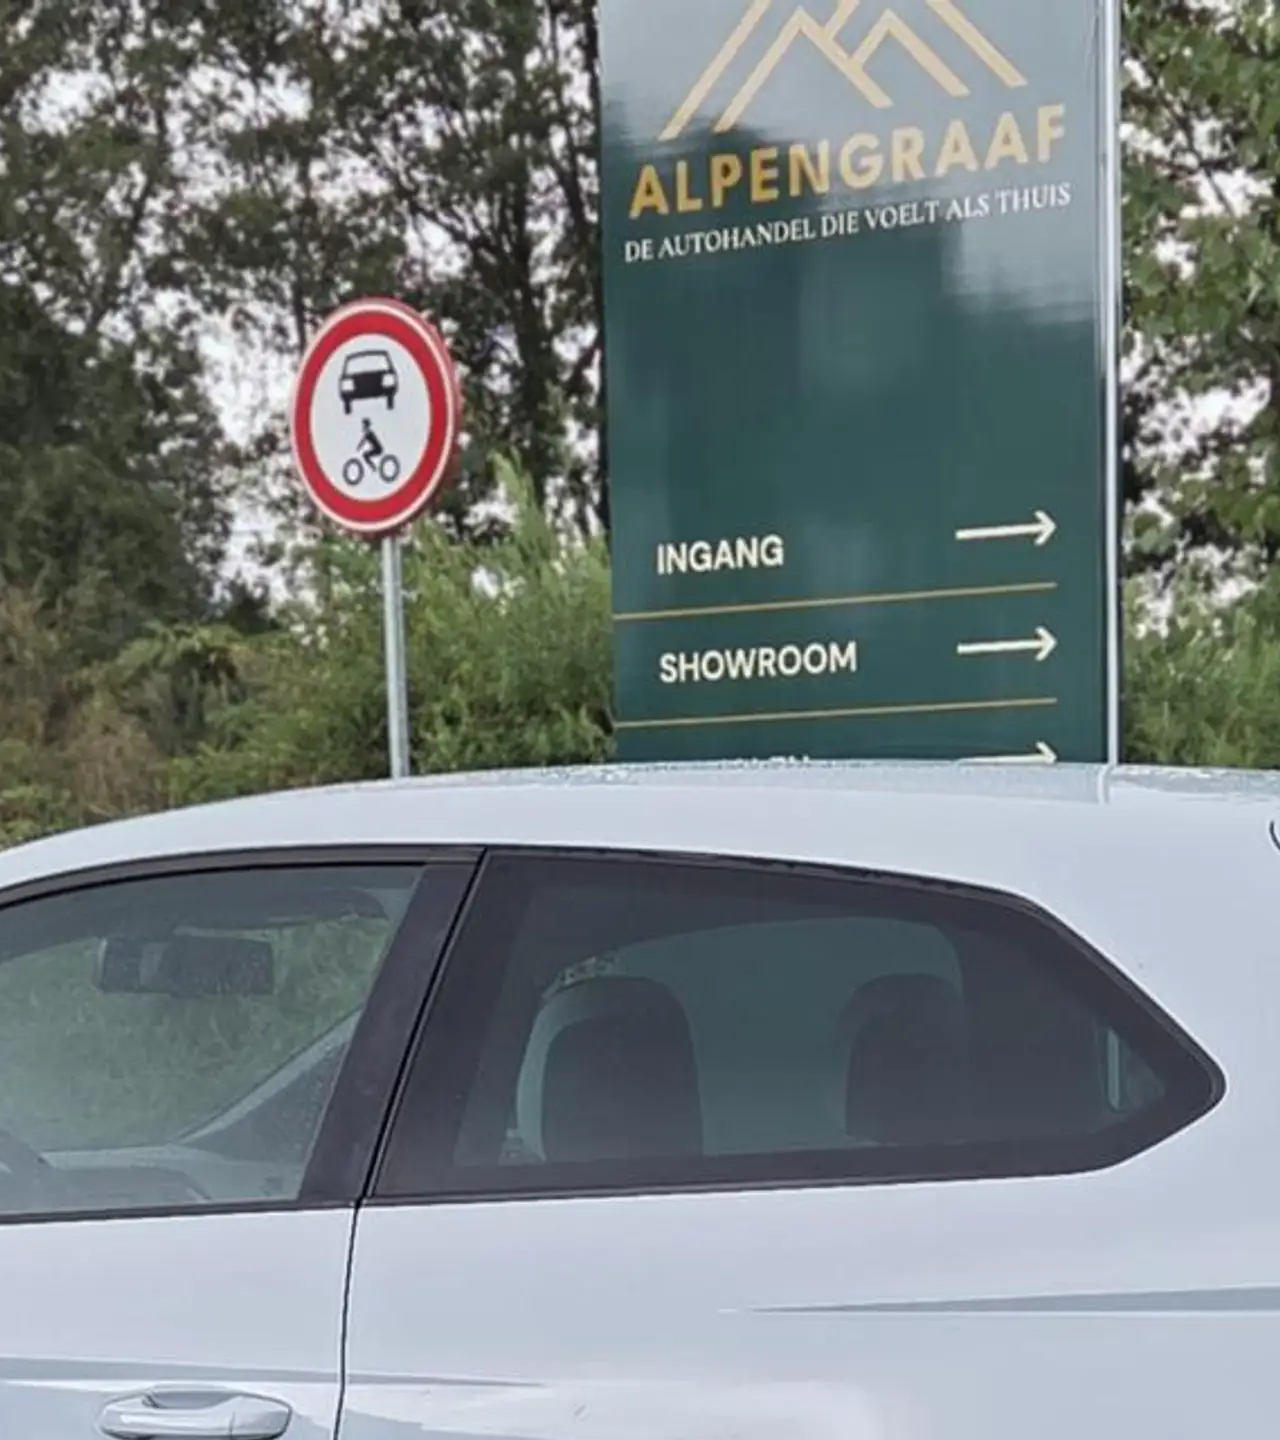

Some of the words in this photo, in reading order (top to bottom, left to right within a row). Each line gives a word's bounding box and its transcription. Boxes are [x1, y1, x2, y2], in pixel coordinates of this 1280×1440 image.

[628, 103, 1066, 219] ALPENGRAAF
[624, 239, 654, 263] DE
[657, 217, 816, 259] AUTOHANDEL
[821, 210, 860, 238] DIE
[864, 199, 940, 231] VOELT
[945, 193, 991, 222] ALS
[994, 181, 1072, 215] THUIS
[657, 534, 785, 576] INGANG
[658, 641, 858, 685] SHOWROOM
